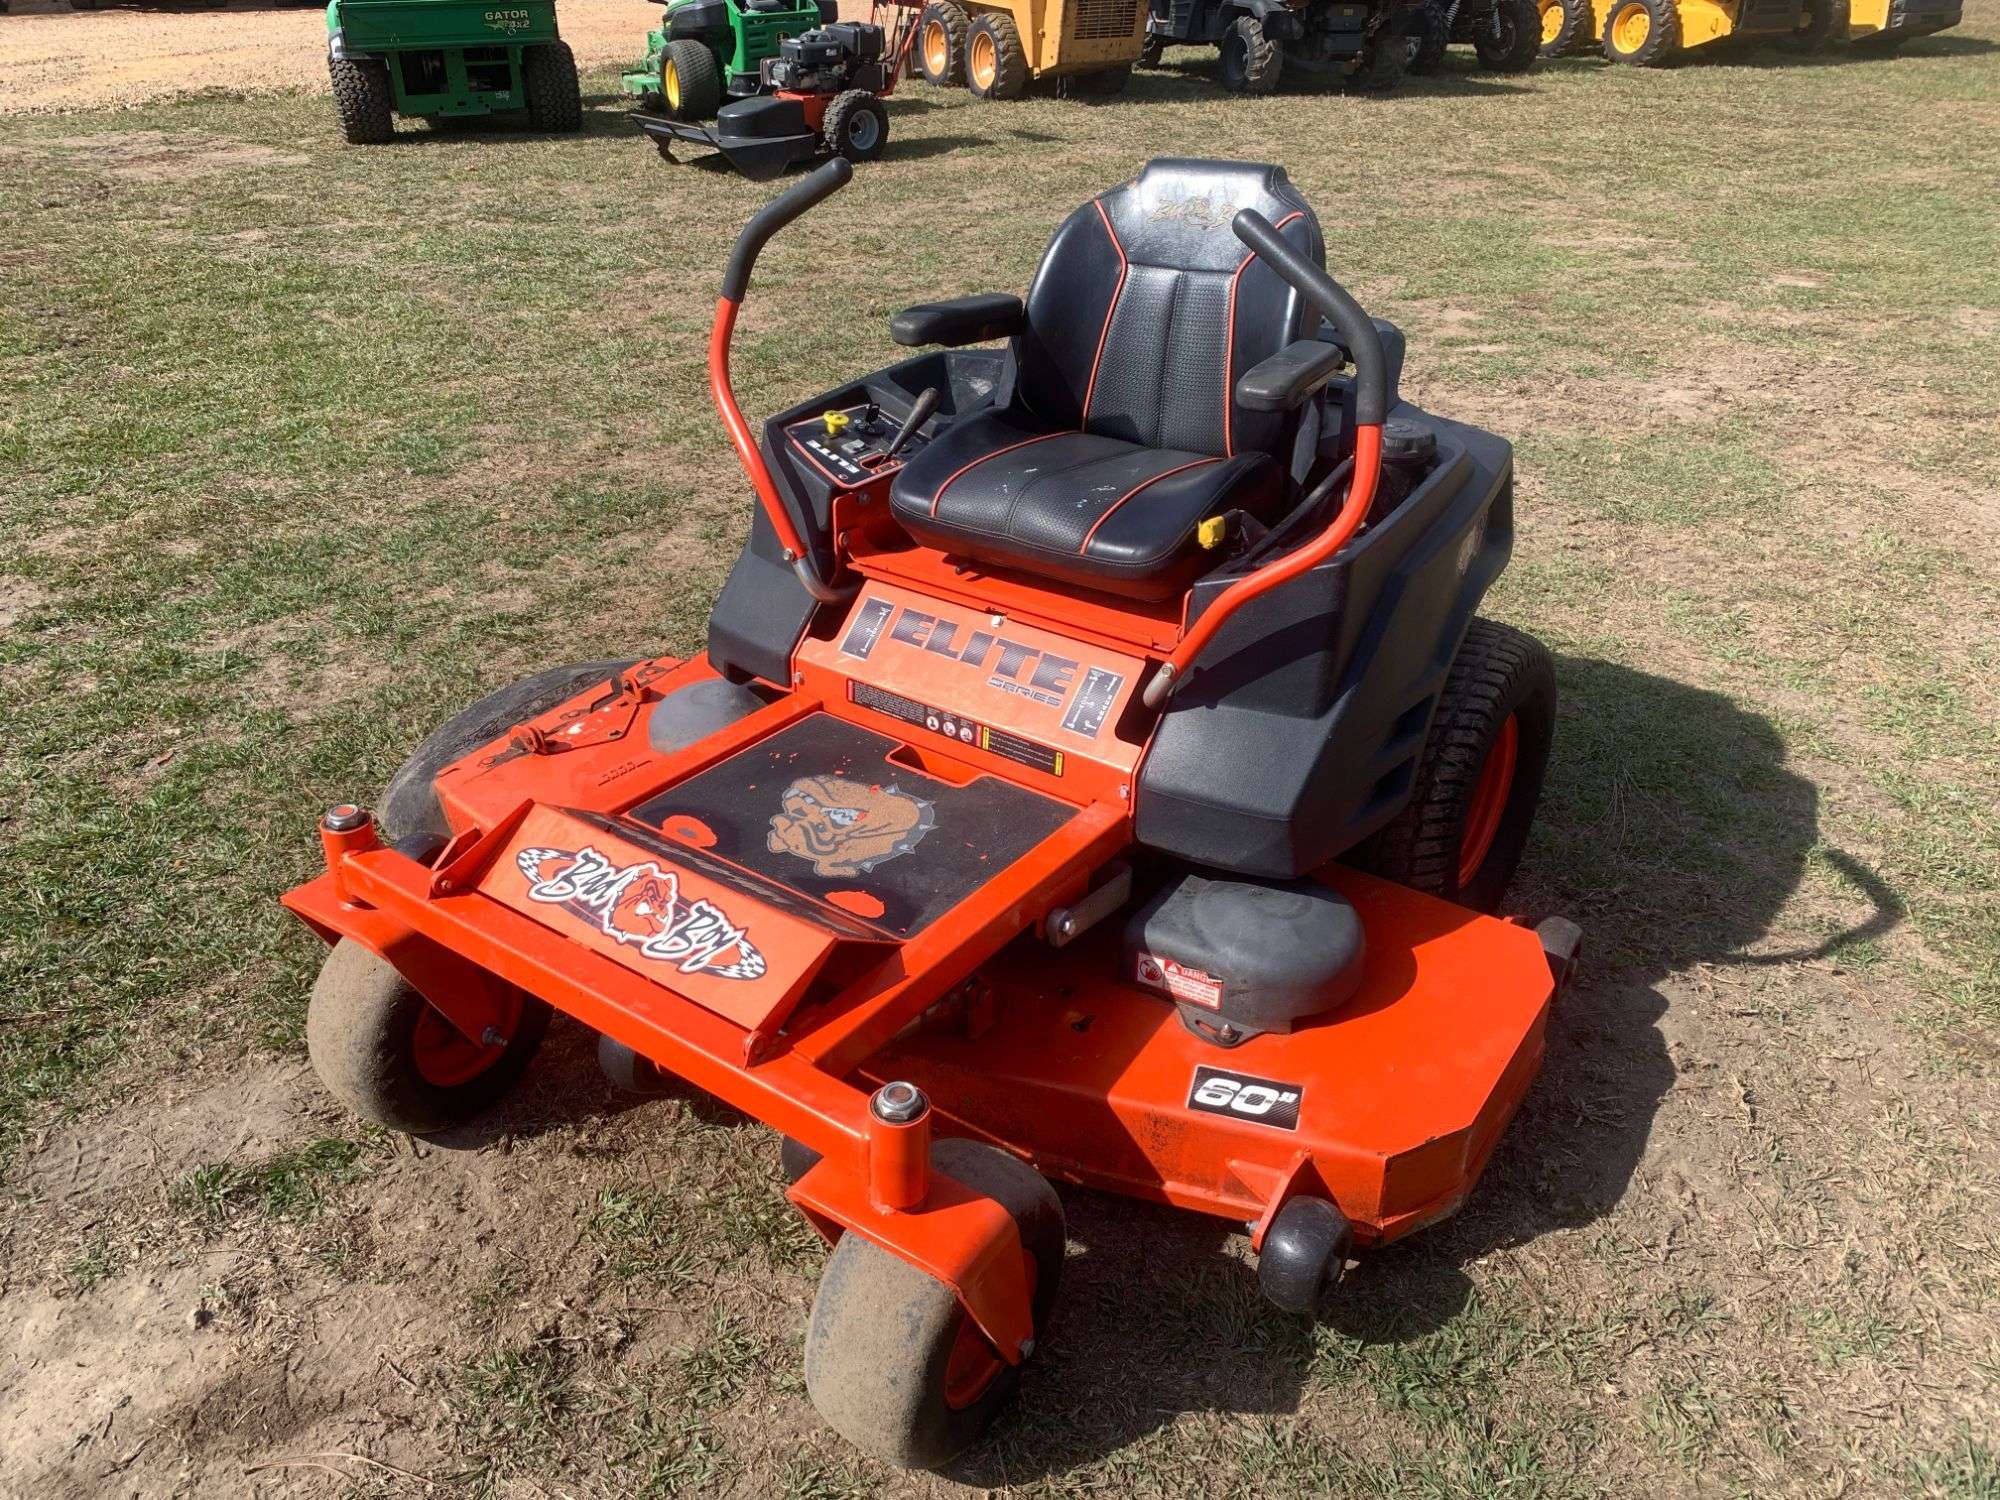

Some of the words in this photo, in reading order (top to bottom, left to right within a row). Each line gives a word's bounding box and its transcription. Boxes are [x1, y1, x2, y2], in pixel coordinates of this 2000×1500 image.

[484, 9, 528, 20] GATOR
[889, 608, 1079, 695] ELITE
[988, 677, 1061, 706] SERIES
[532, 847, 634, 906] Bad
[644, 902, 744, 970] Boy
